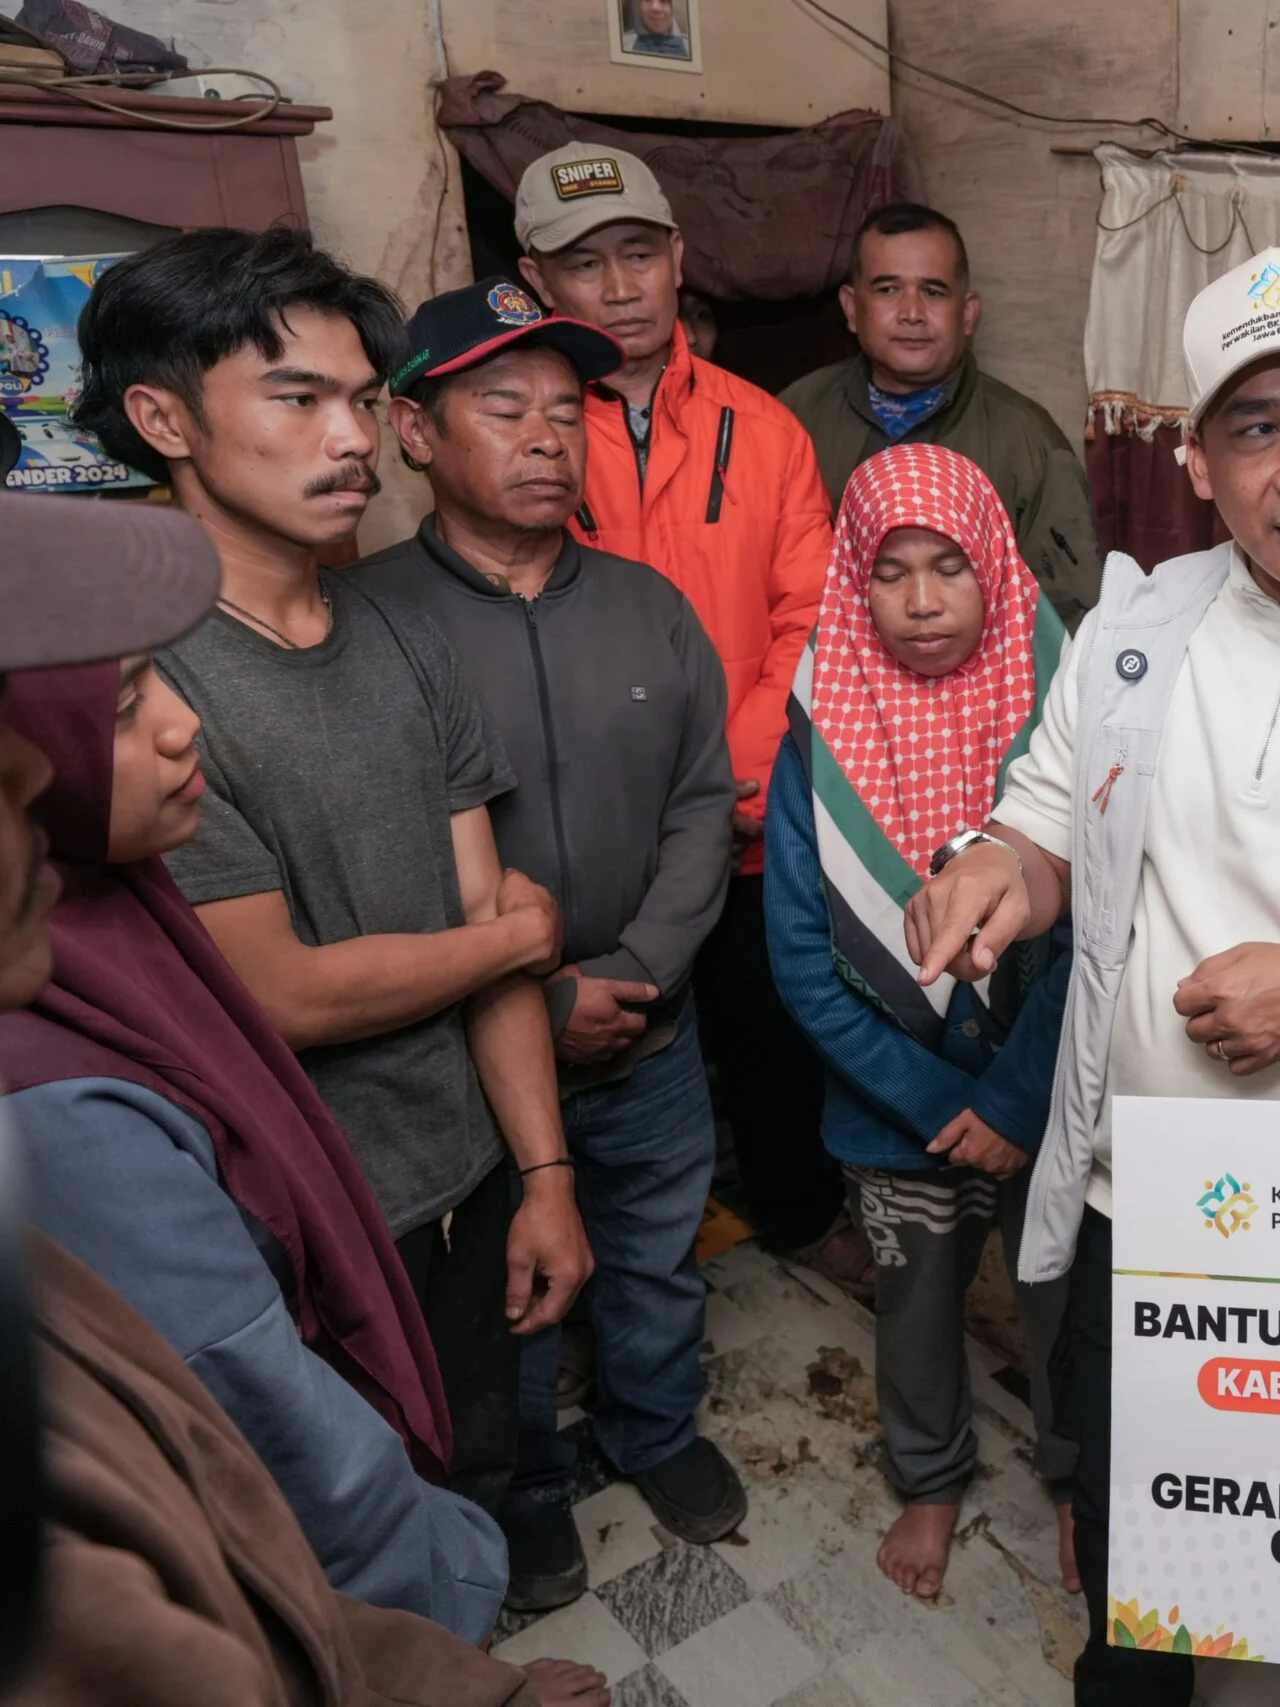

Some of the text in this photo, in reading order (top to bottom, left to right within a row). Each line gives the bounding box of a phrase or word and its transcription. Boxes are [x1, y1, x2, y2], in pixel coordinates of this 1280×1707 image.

[557, 162, 615, 185] SNIPER
[1221, 324, 1266, 351] Perwakilan
[1252, 330, 1276, 342] Jawa
[6, 463, 127, 486] ENDER 2024
[842, 1164, 908, 1268] didas
